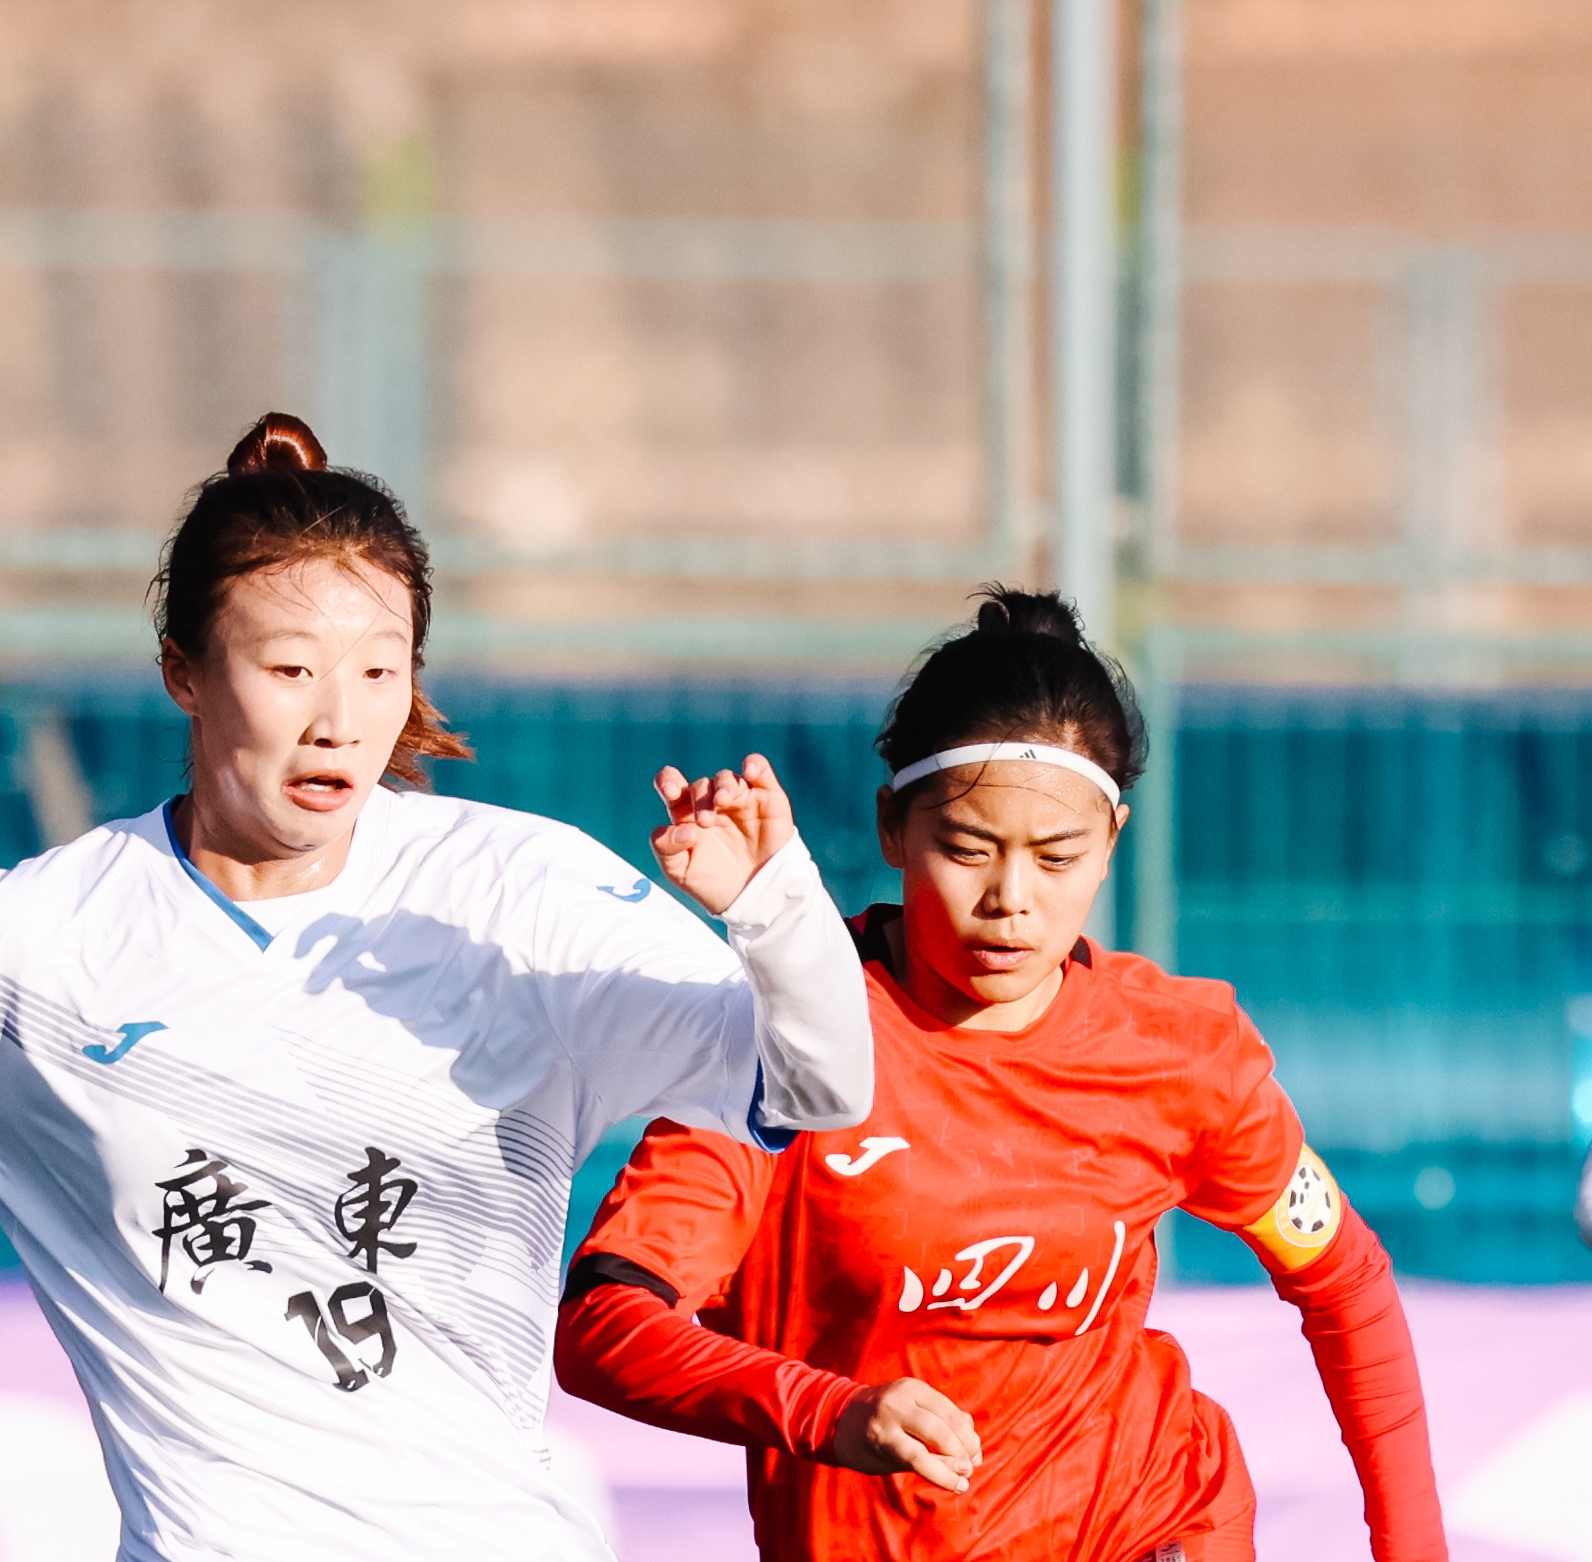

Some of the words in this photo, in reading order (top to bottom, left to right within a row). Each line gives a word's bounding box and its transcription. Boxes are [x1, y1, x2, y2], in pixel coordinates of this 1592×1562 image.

[151, 1145, 419, 1296] 廣東
[899, 1220, 1126, 1337] 四川
[284, 1281, 398, 1393] 19
